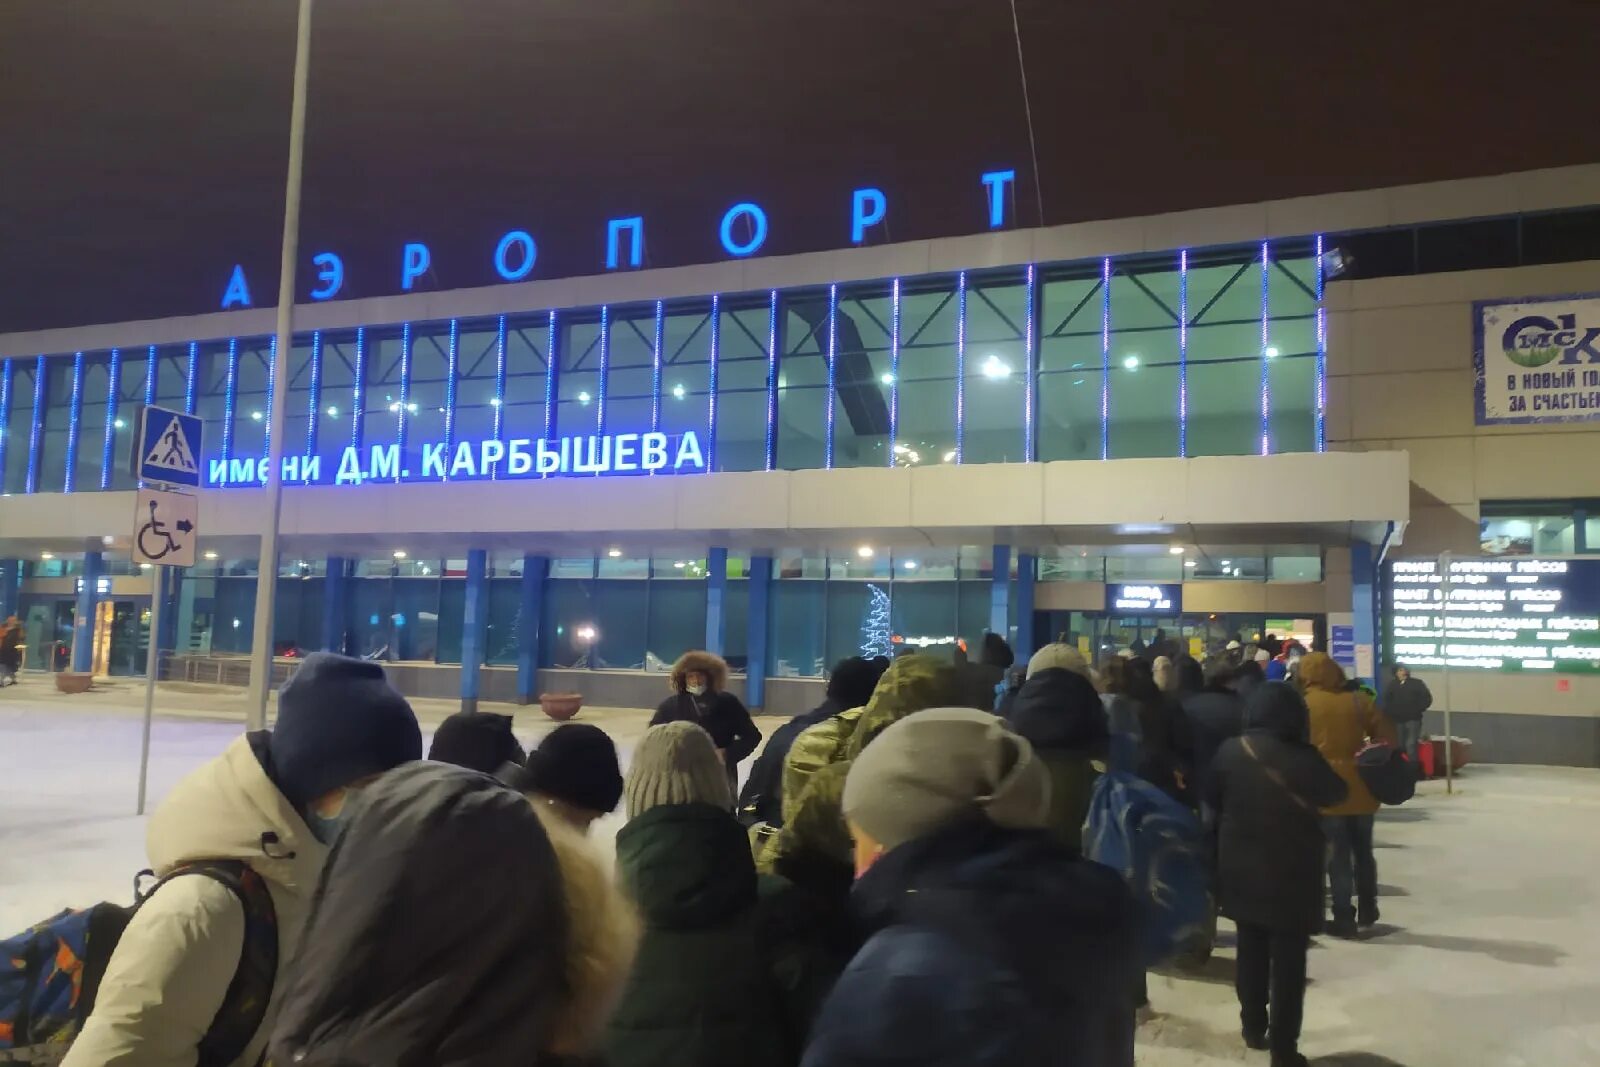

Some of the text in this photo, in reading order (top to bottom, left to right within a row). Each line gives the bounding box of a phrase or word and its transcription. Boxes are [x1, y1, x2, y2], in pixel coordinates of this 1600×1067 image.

[221, 169, 1016, 309] АЭРОПОРТ
[1508, 368, 1600, 390] В НОВЫЙ ГО
[1509, 395, 1527, 412] ЗА
[422, 430, 704, 477] КАРБЫШЕВА
